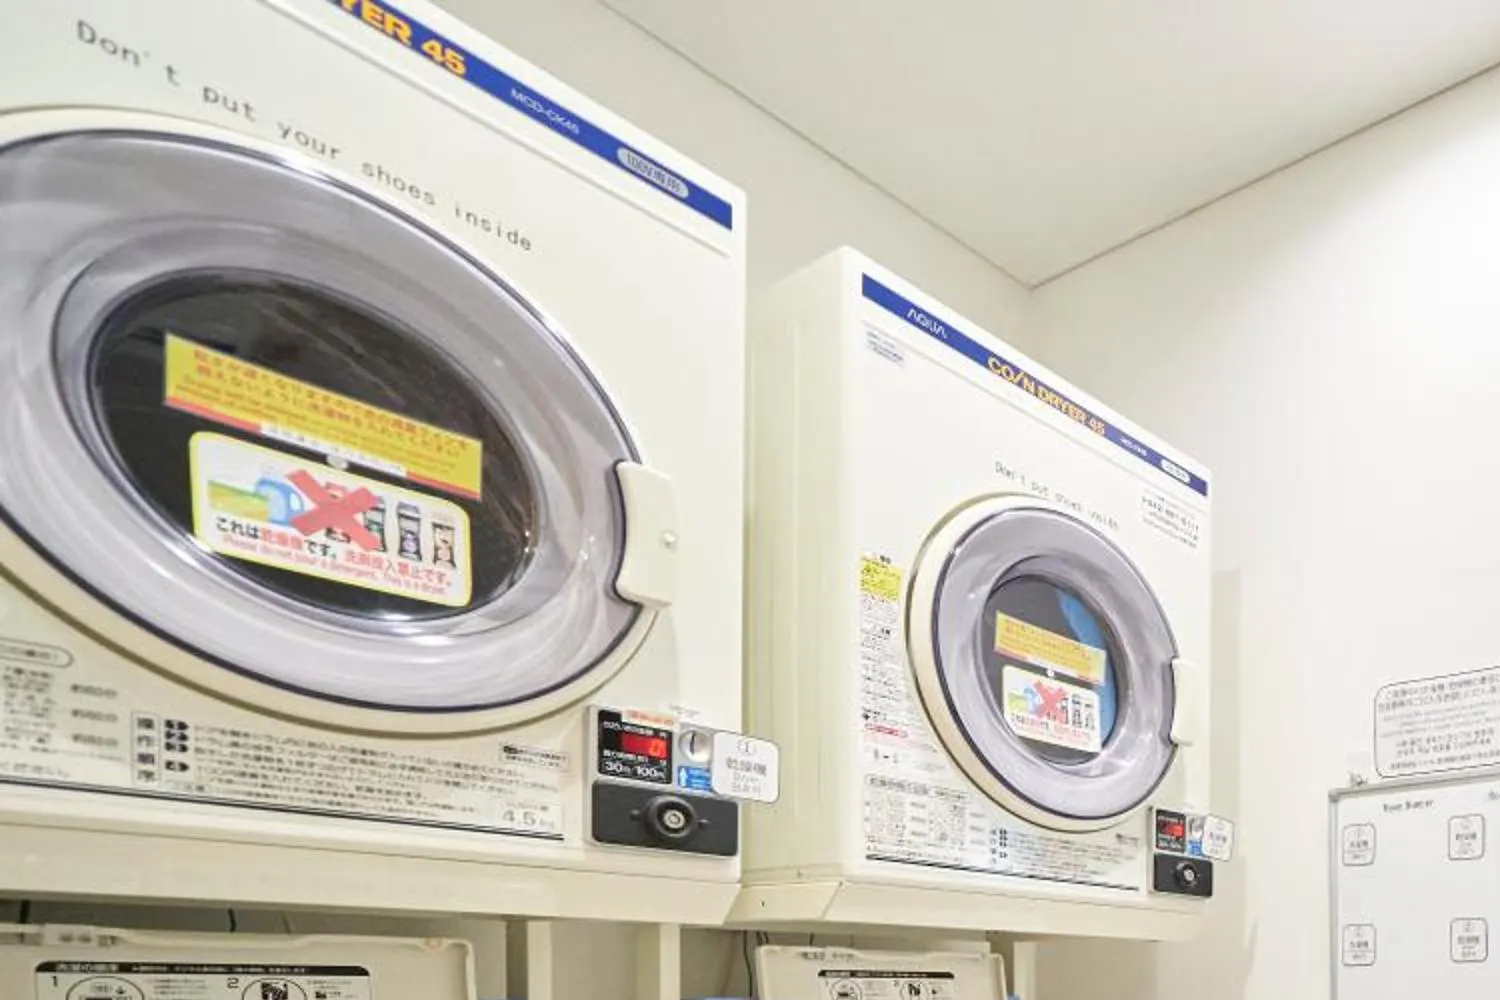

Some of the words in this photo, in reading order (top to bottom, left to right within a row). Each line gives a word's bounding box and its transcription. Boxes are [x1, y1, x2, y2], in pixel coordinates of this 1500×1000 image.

[420, 38, 467, 76] 45
[202, 86, 256, 121] put
[277, 121, 341, 160] your
[362, 162, 436, 205] shoes
[455, 200, 532, 250] inside
[907, 308, 948, 339] AQUA
[1037, 384, 1087, 425] DRYER
[1089, 418, 1106, 435] 45
[51, 975, 58, 988] 1
[226, 977, 240, 989] 2
